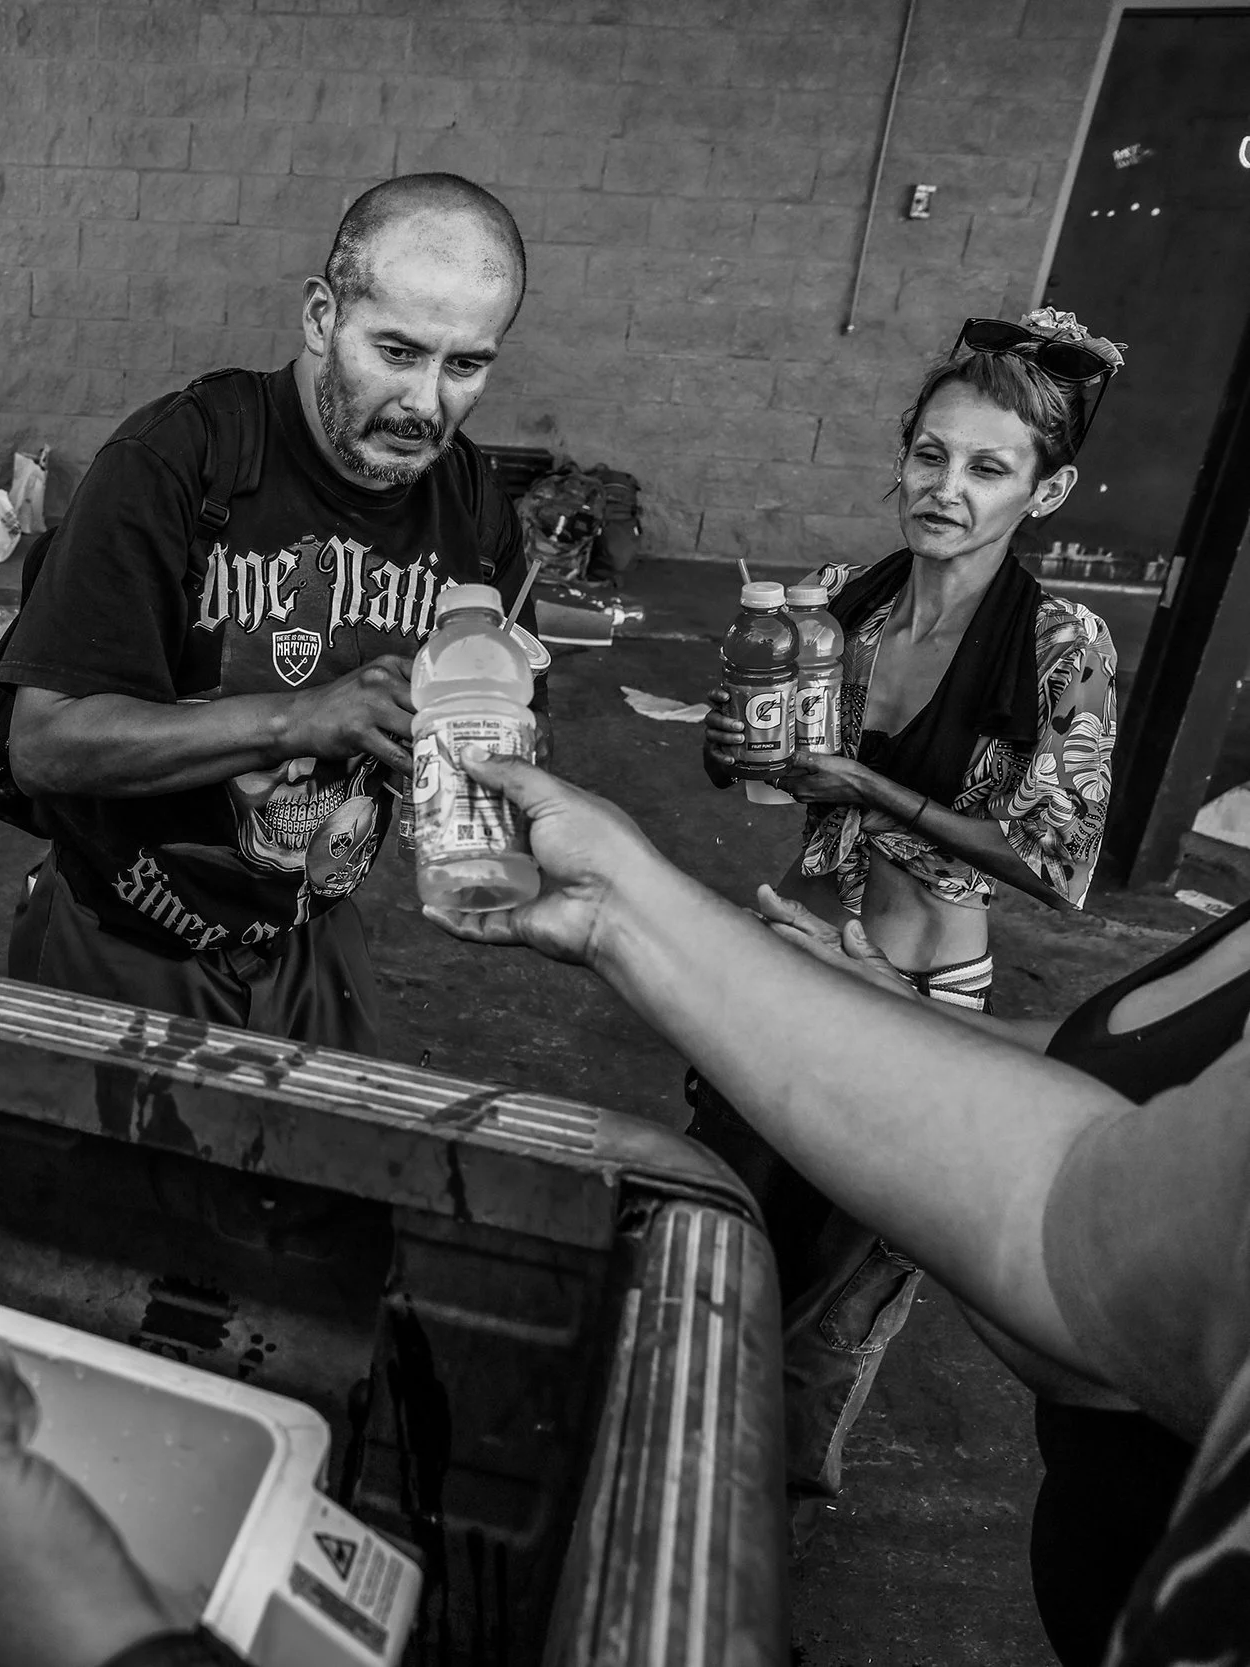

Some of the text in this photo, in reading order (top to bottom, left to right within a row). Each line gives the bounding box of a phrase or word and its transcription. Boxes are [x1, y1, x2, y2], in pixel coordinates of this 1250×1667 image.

[192, 535, 460, 647] One Nati
[276, 642, 318, 656] NATION
[452, 720, 500, 729] Nutrition Facts
[745, 691, 783, 730] G
[796, 687, 825, 725] G
[111, 847, 230, 951] Since
